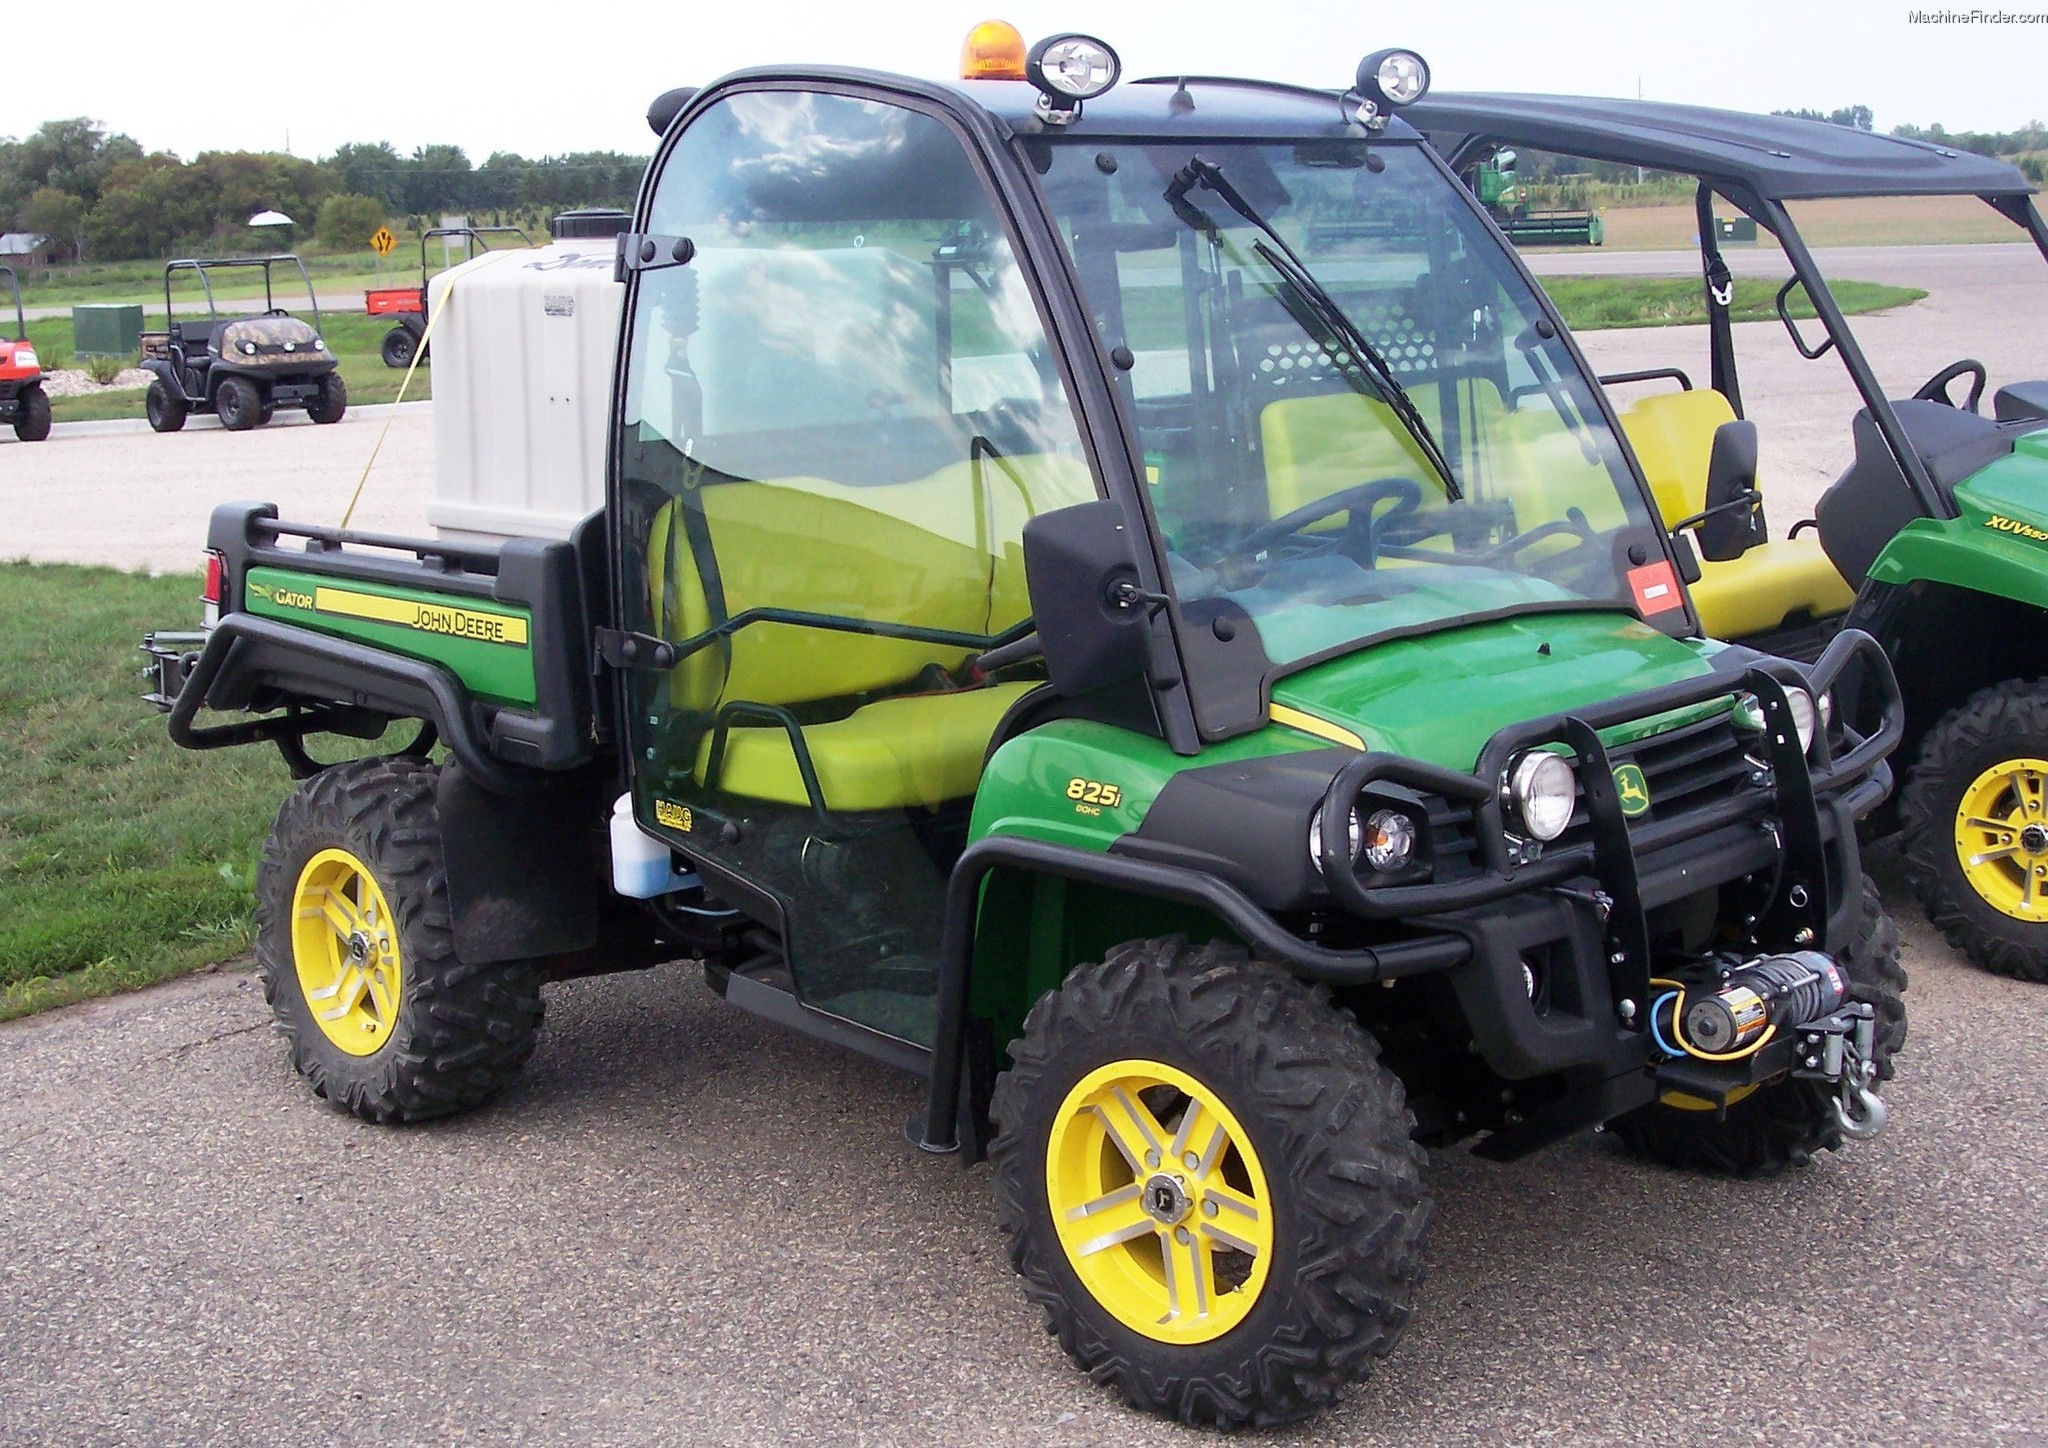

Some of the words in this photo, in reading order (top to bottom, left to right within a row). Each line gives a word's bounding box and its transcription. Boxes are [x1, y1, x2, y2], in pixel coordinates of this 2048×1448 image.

[412, 605, 452, 631] JOHN
[455, 611, 504, 639] DEERE
[1066, 777, 1121, 807] 825i
